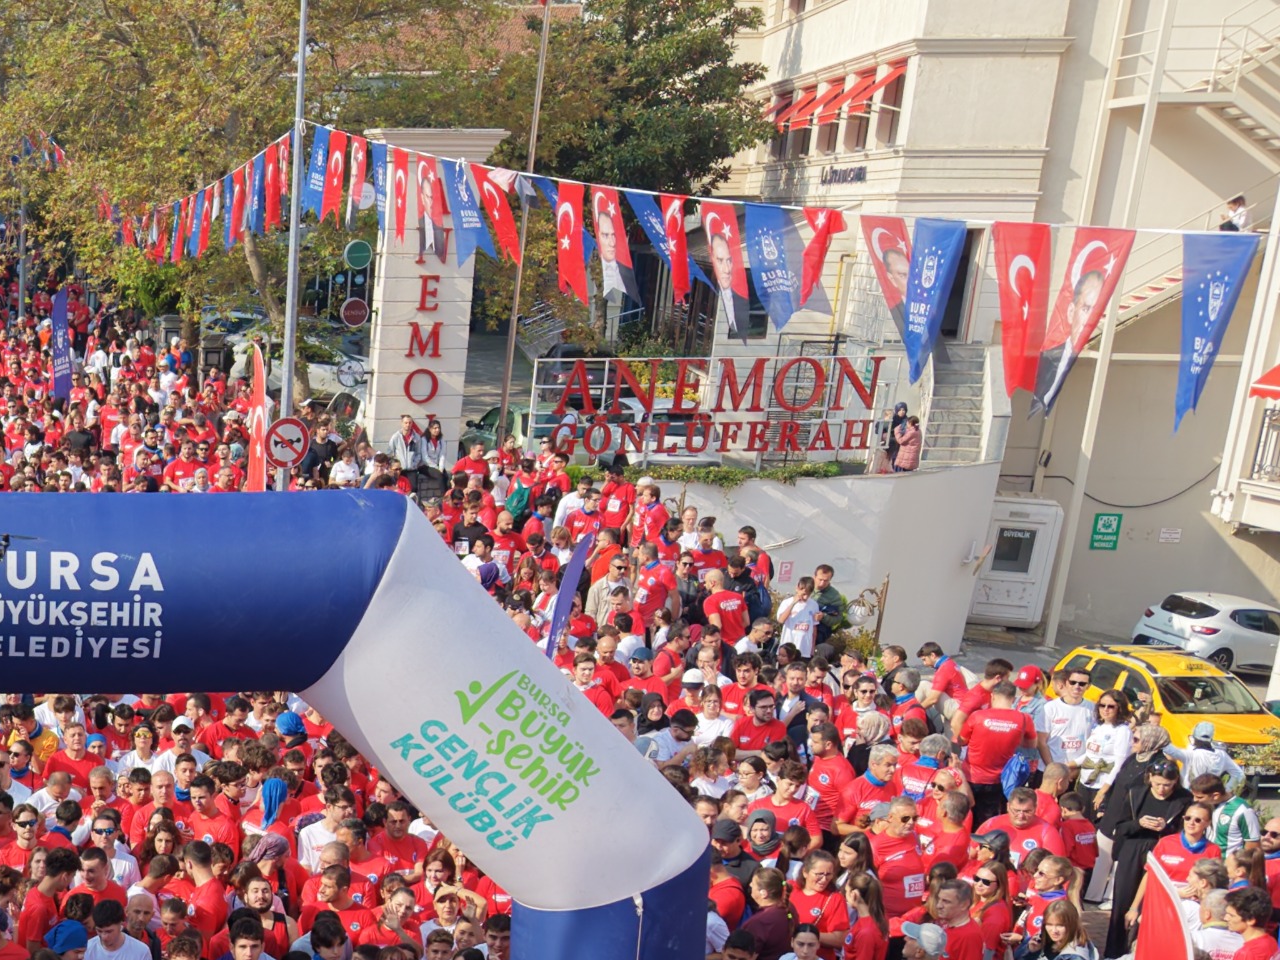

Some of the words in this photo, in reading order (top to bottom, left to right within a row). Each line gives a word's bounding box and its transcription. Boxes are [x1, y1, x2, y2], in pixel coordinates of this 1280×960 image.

[552, 356, 886, 415] ANEMON
[551, 413, 870, 455] GÖNLÜFERAH
[1003, 530, 1031, 539] GÜVENLİK
[389, 733, 519, 851] KULÜBÜ
